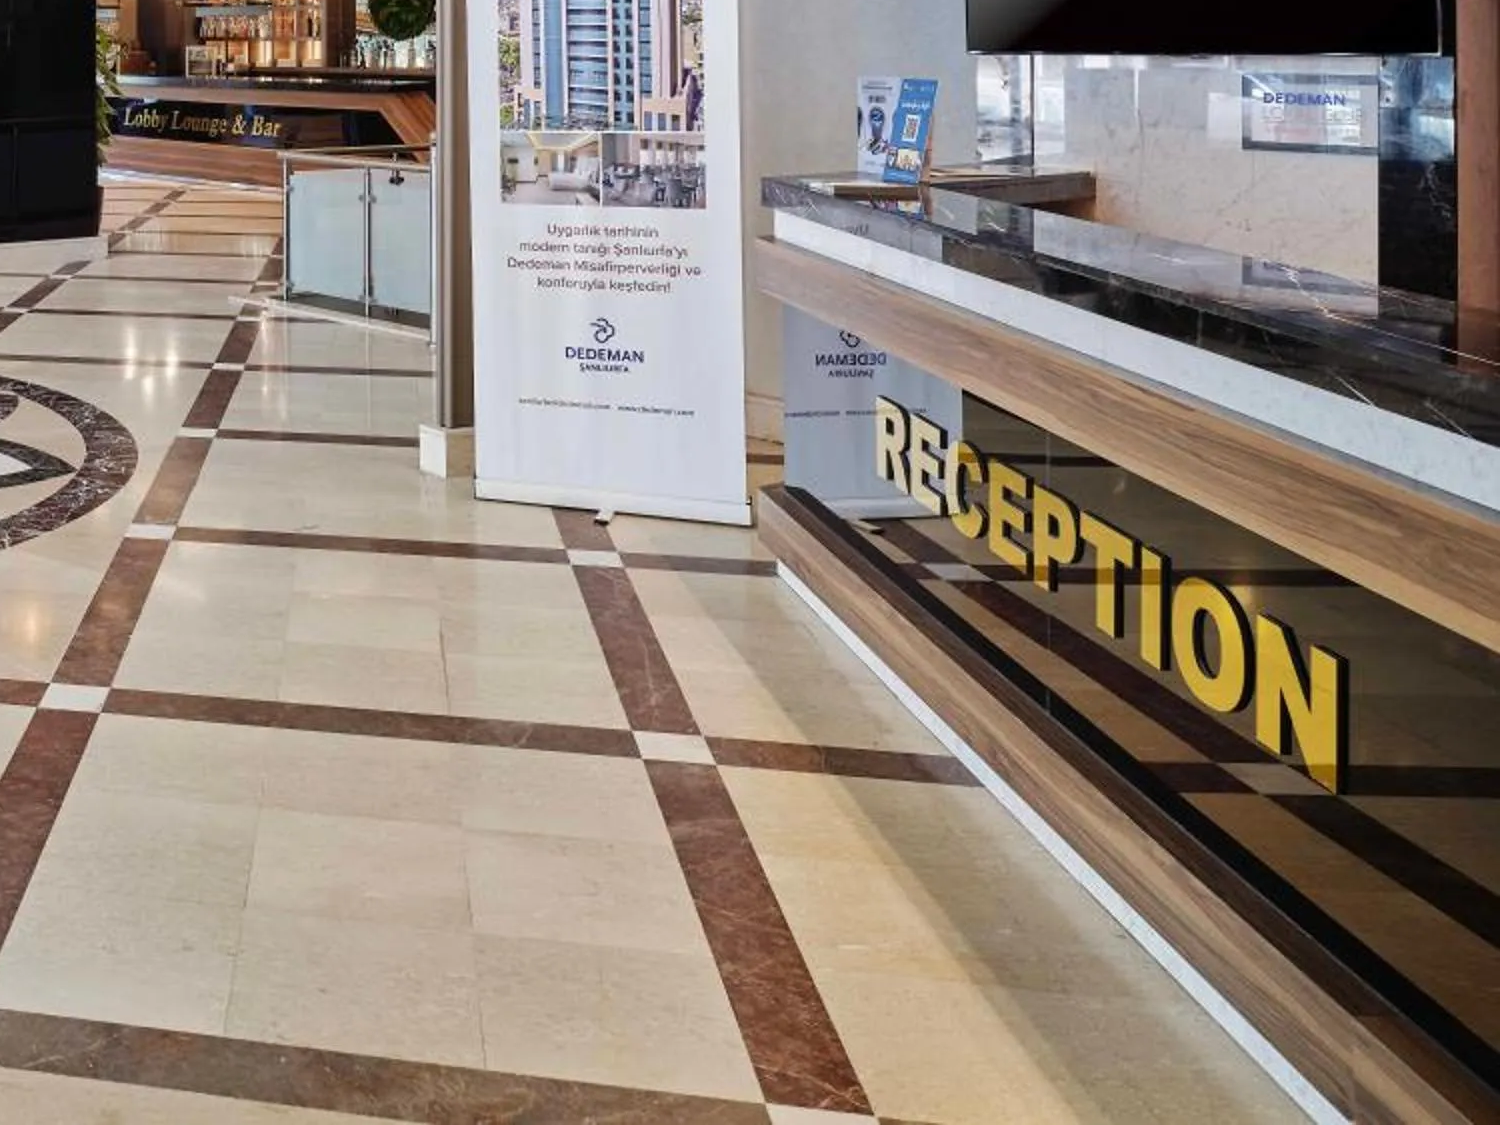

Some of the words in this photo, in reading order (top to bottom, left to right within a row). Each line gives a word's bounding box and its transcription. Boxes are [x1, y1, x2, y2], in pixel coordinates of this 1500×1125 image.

[1263, 92, 1346, 106] DEDEMAN
[123, 107, 167, 132] Lobby
[172, 110, 227, 137] Lounge
[231, 114, 246, 135] &
[252, 115, 283, 137] Bar
[519, 241, 571, 253] modern
[507, 256, 571, 270] Dedeman
[685, 265, 702, 276] ve
[565, 346, 645, 364] DEDEMAN
[876, 395, 1348, 795] RECEPTION
